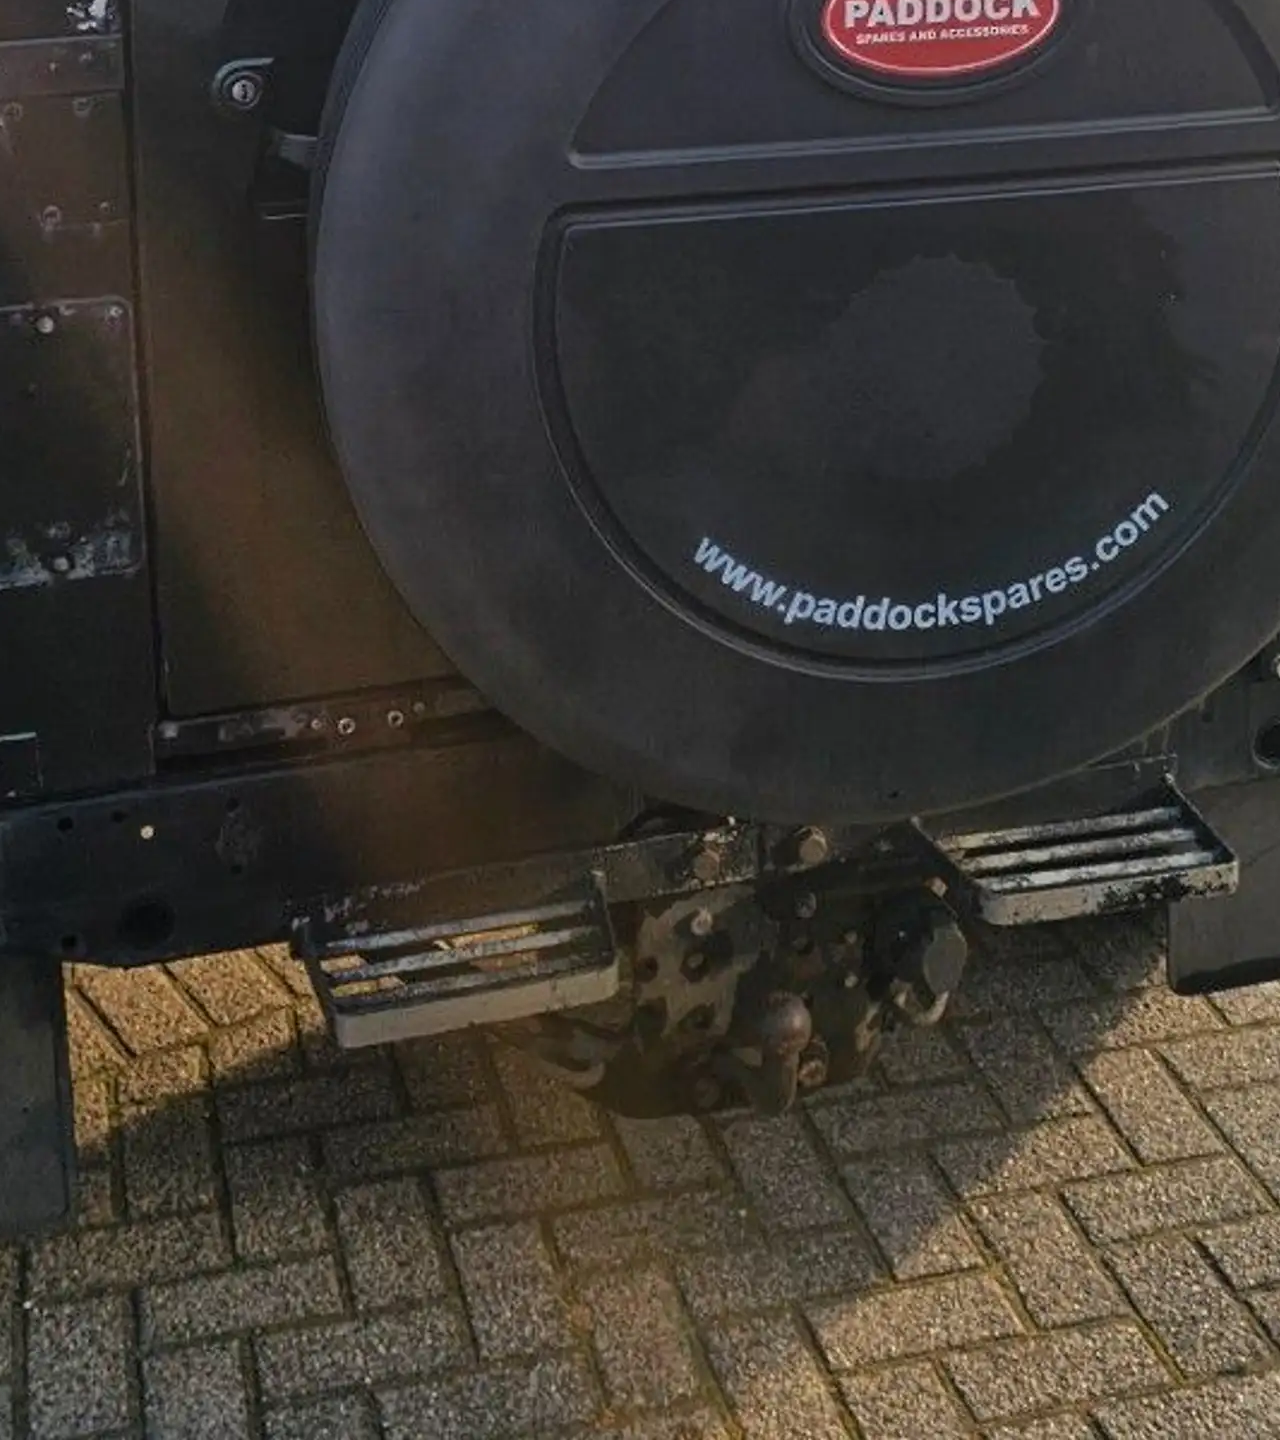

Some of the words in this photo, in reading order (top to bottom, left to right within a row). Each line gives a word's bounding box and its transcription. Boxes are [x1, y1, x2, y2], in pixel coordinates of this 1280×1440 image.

[856, 31, 905, 45] SPARES
[909, 28, 936, 41] AND
[940, 23, 1029, 40] ACCESSORIES
[693, 490, 1170, 631] www.paddockspares.com
